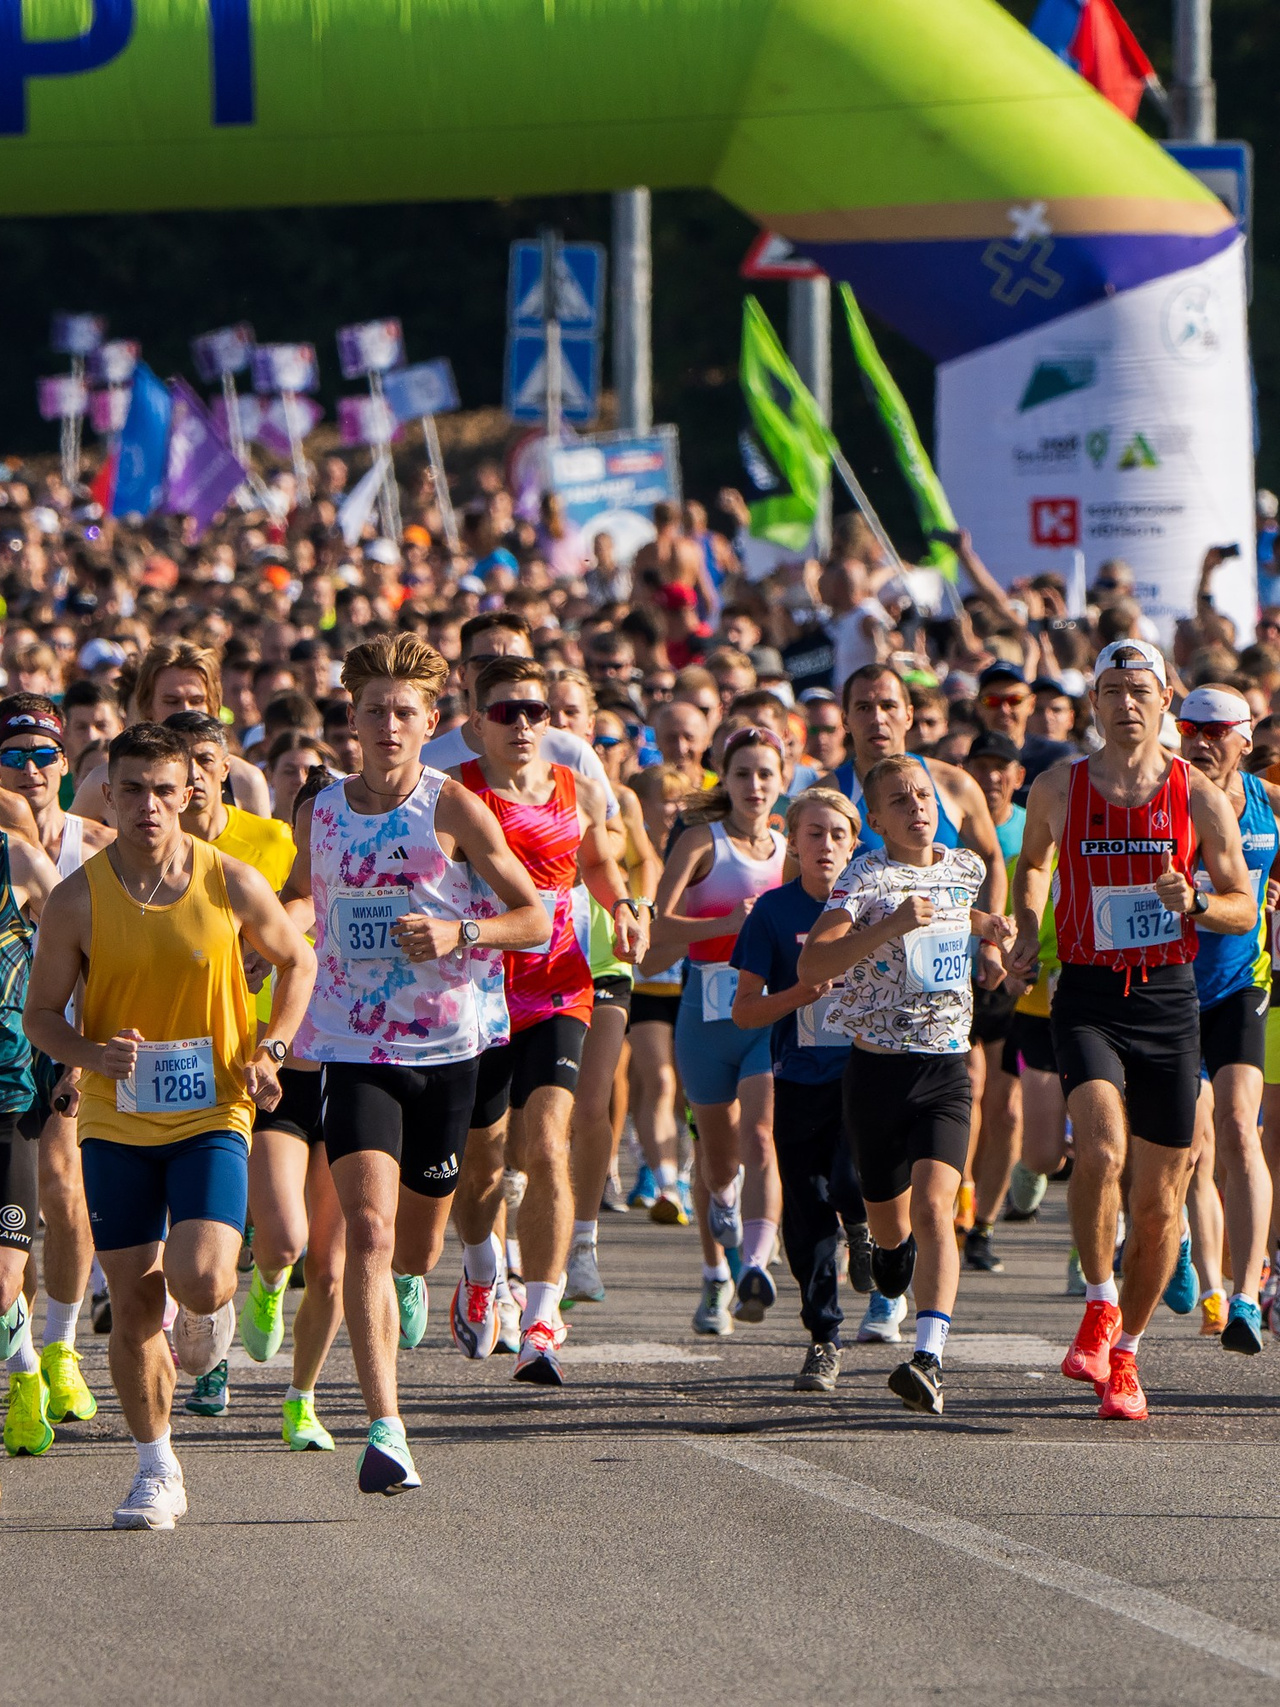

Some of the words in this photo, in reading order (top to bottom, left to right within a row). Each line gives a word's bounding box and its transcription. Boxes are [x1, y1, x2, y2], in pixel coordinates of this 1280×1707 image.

[1085, 841, 1124, 854] PRO
[352, 905, 393, 919] МИХАИЛ
[1126, 911, 1175, 940] 1372
[933, 953, 968, 983] 2297
[154, 1055, 198, 1072] АЛЕКСЕЙ
[152, 1072, 207, 1104] 1285
